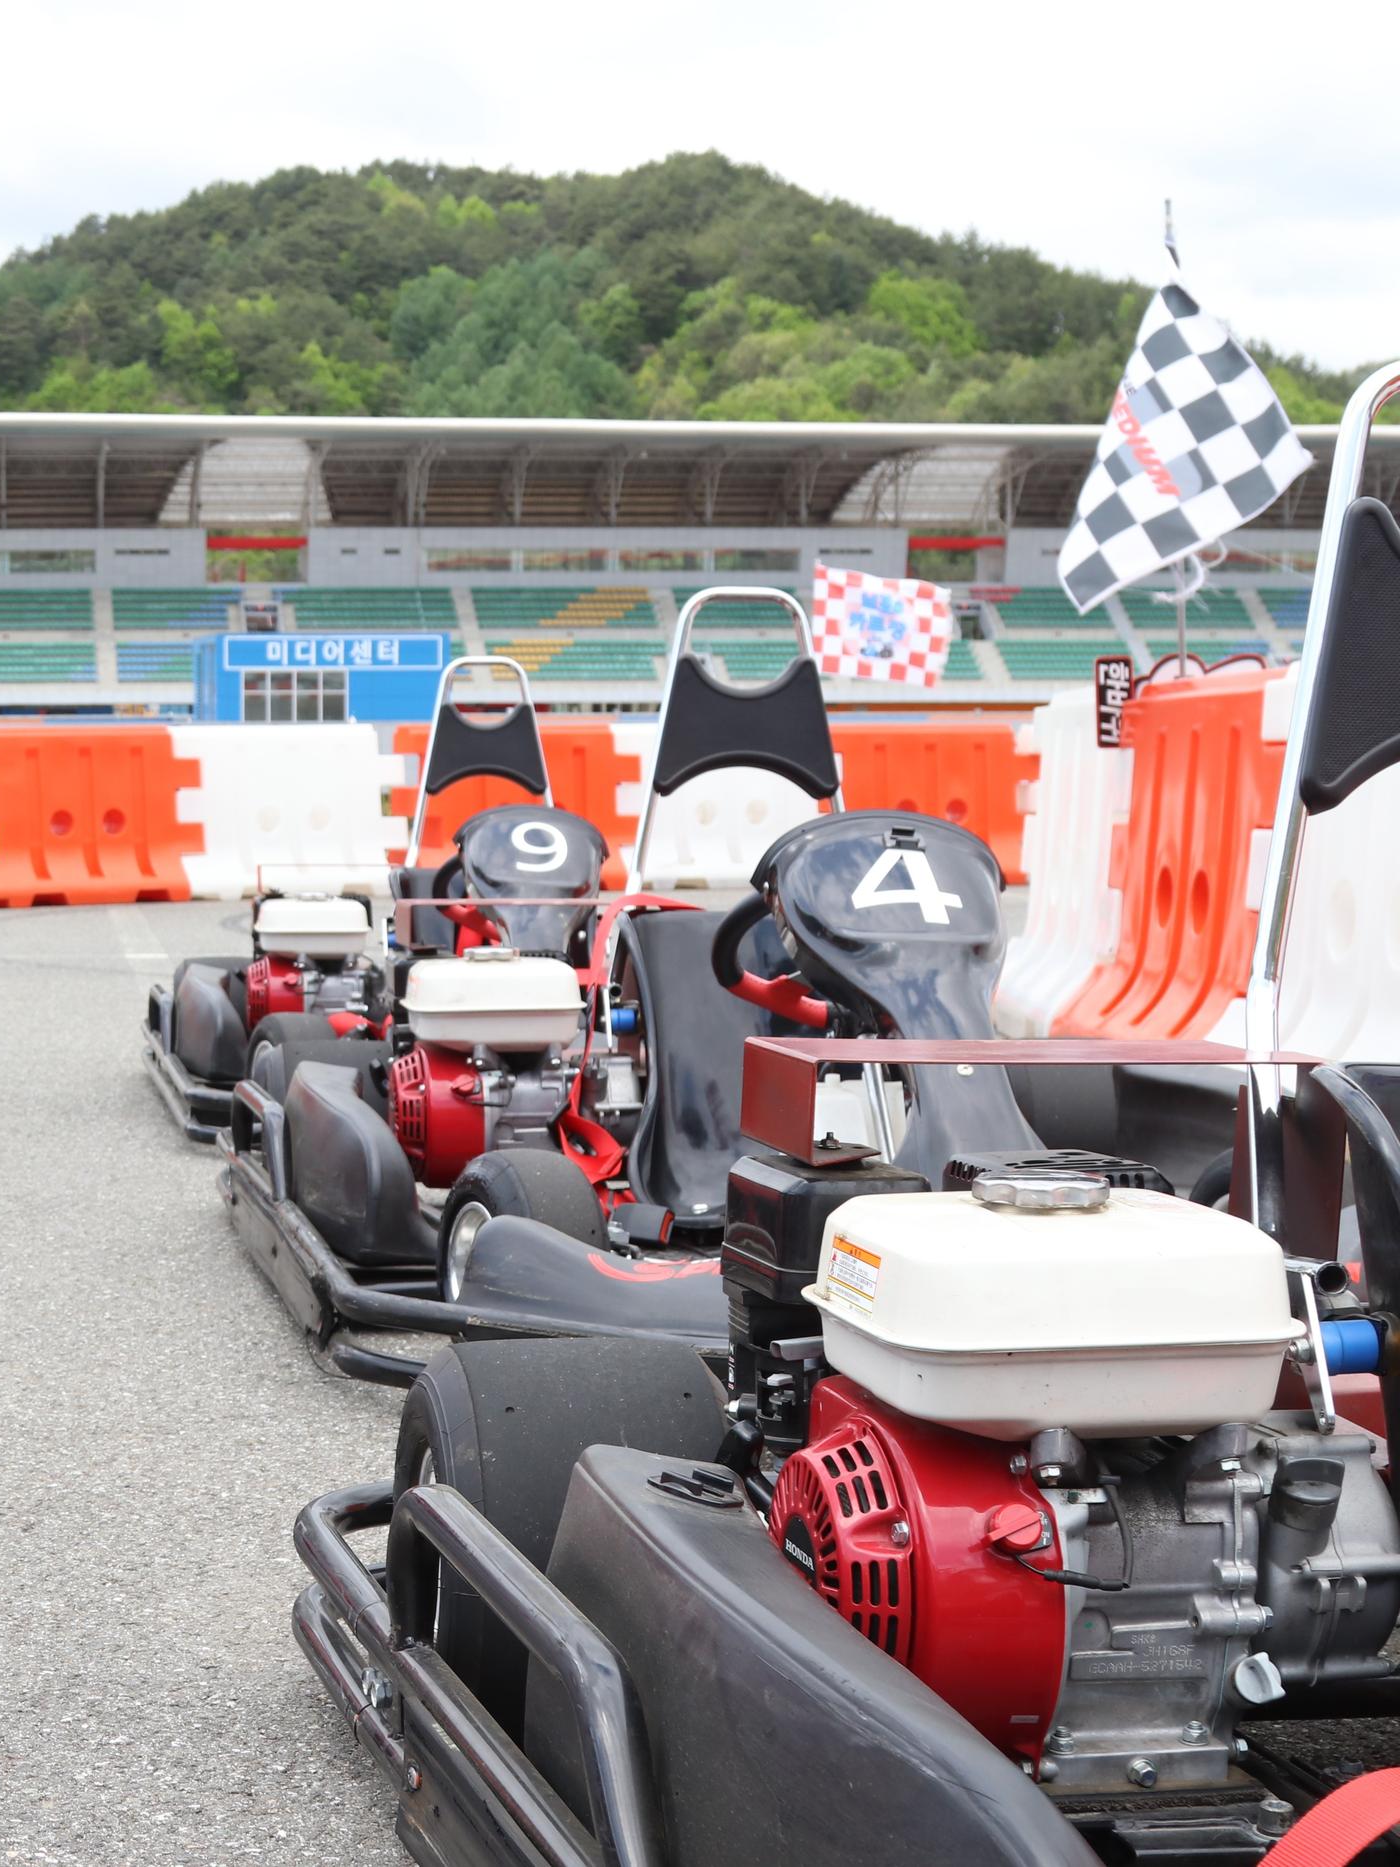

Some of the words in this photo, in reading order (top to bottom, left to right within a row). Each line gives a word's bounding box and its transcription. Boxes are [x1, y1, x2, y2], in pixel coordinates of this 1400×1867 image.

[266, 638, 400, 666] 미디어센터
[510, 821, 570, 873] 9
[851, 847, 964, 926] 4
[785, 1537, 814, 1571] HONDA
